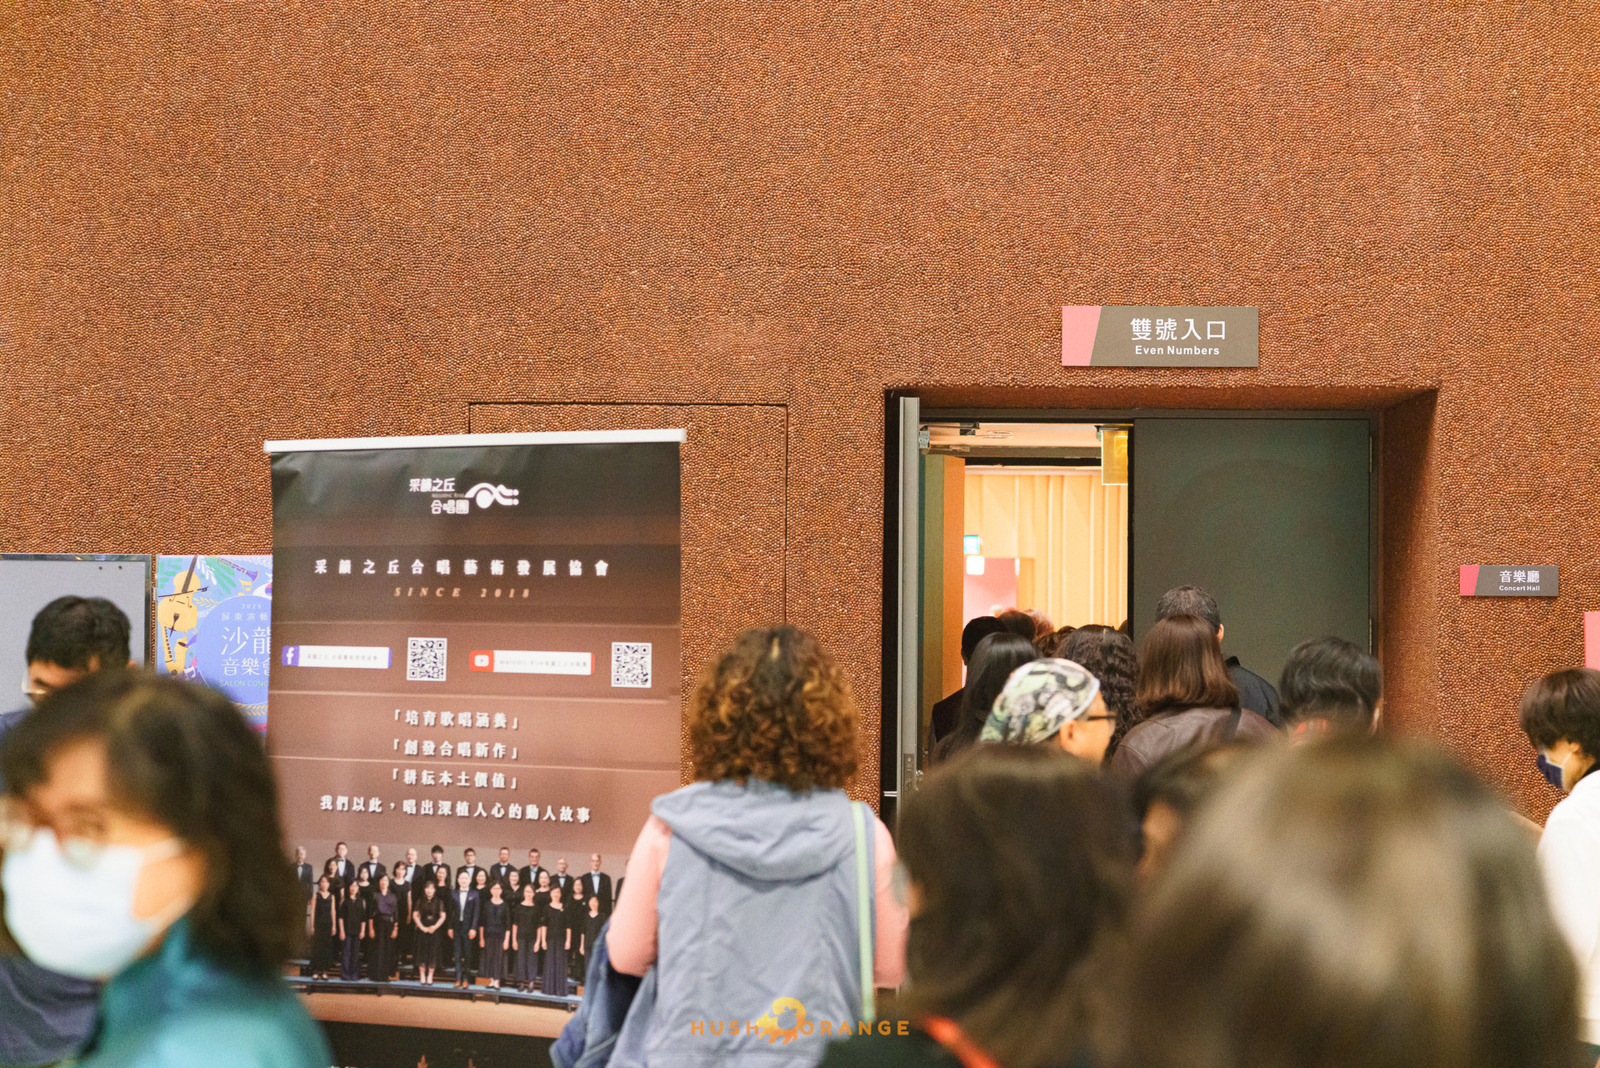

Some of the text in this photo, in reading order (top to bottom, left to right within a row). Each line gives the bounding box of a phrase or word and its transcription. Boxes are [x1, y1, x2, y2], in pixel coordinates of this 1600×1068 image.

[1129, 317, 1226, 341] 雙號入口
[1135, 345, 1220, 355] Even Numbers
[431, 499, 470, 515] 合唱團
[1499, 570, 1540, 583] 音樂廳
[394, 587, 530, 598] SINCE 2018
[219, 679, 245, 687] SALON
